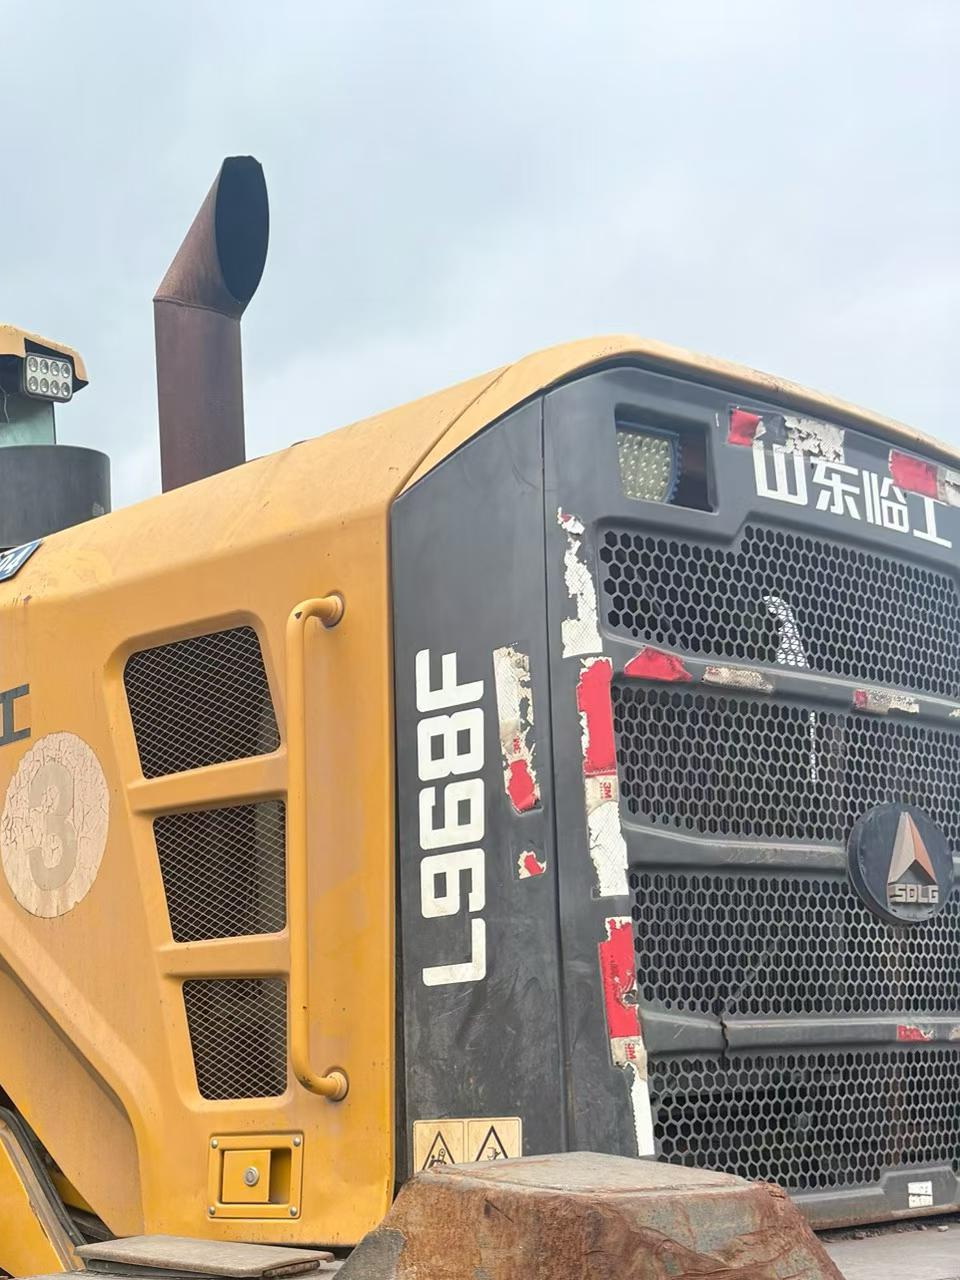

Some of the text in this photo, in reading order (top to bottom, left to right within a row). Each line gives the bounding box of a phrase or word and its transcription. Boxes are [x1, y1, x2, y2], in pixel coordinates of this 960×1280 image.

[752, 443, 952, 549] 山东临工
[28, 761, 77, 891] 3
[415, 649, 486, 987] L968F
[888, 884, 938, 903] SDLG
